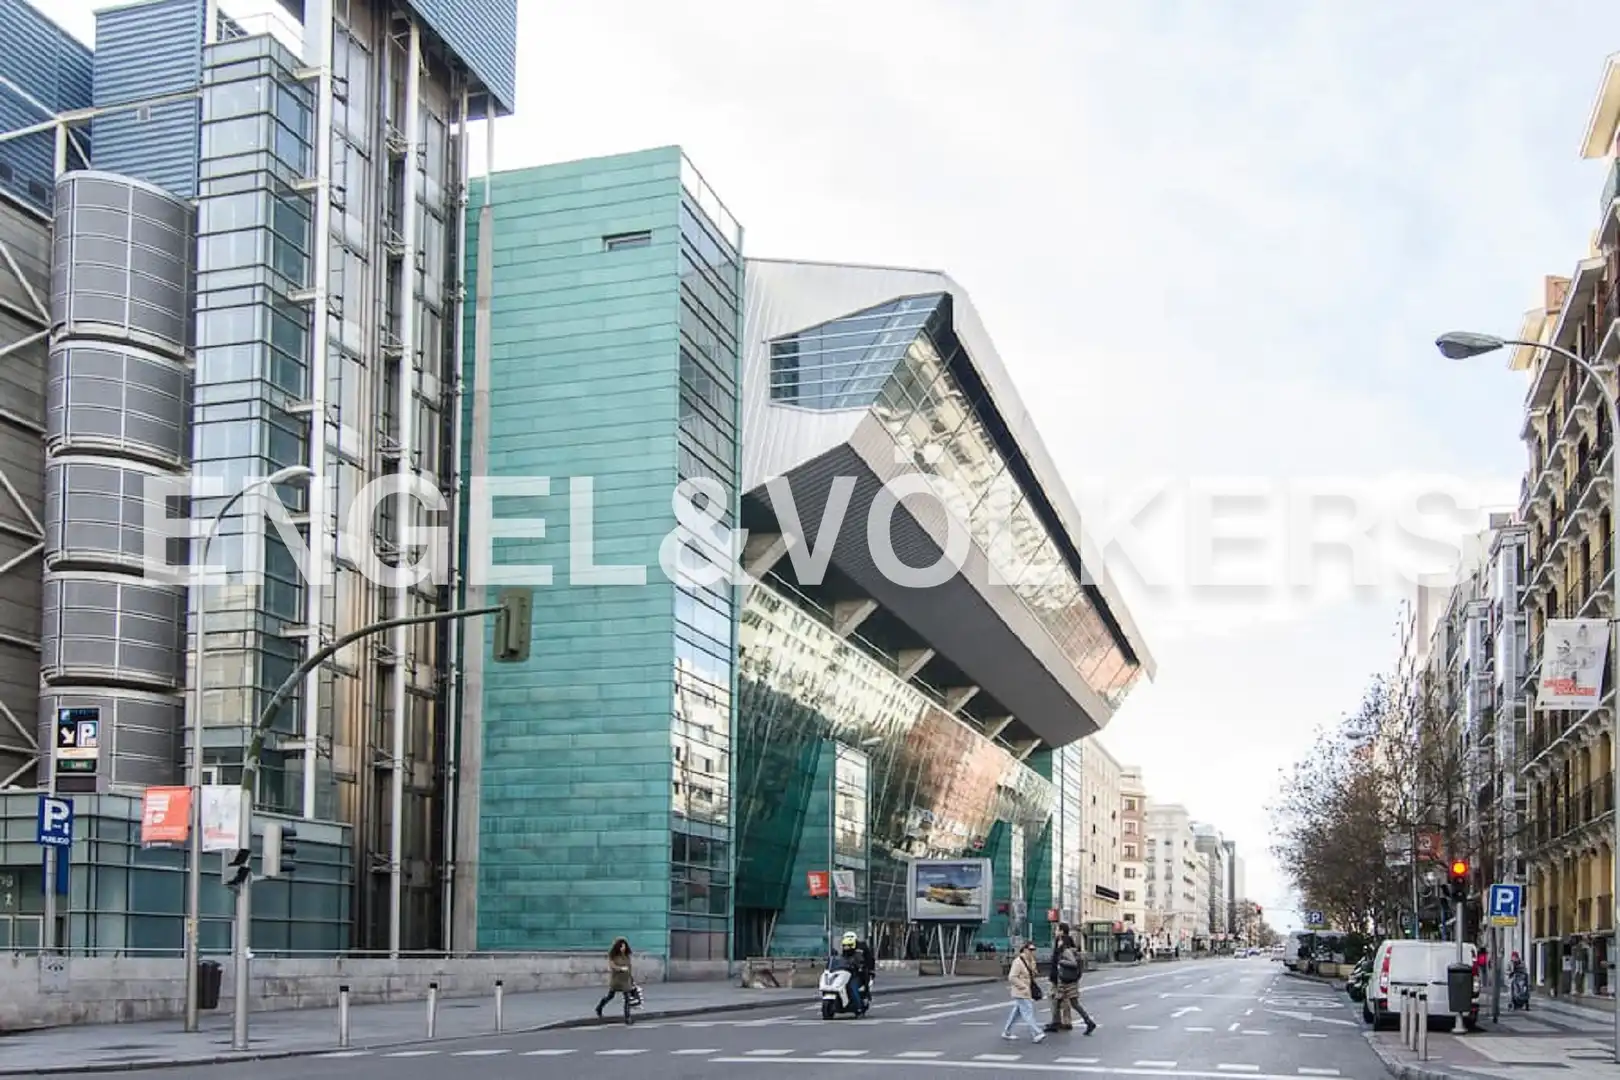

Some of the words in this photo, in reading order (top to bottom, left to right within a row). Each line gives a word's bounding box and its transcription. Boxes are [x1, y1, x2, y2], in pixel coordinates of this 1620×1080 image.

[80, 723, 96, 746] P
[44, 799, 70, 831] P
[1496, 888, 1514, 911] P
